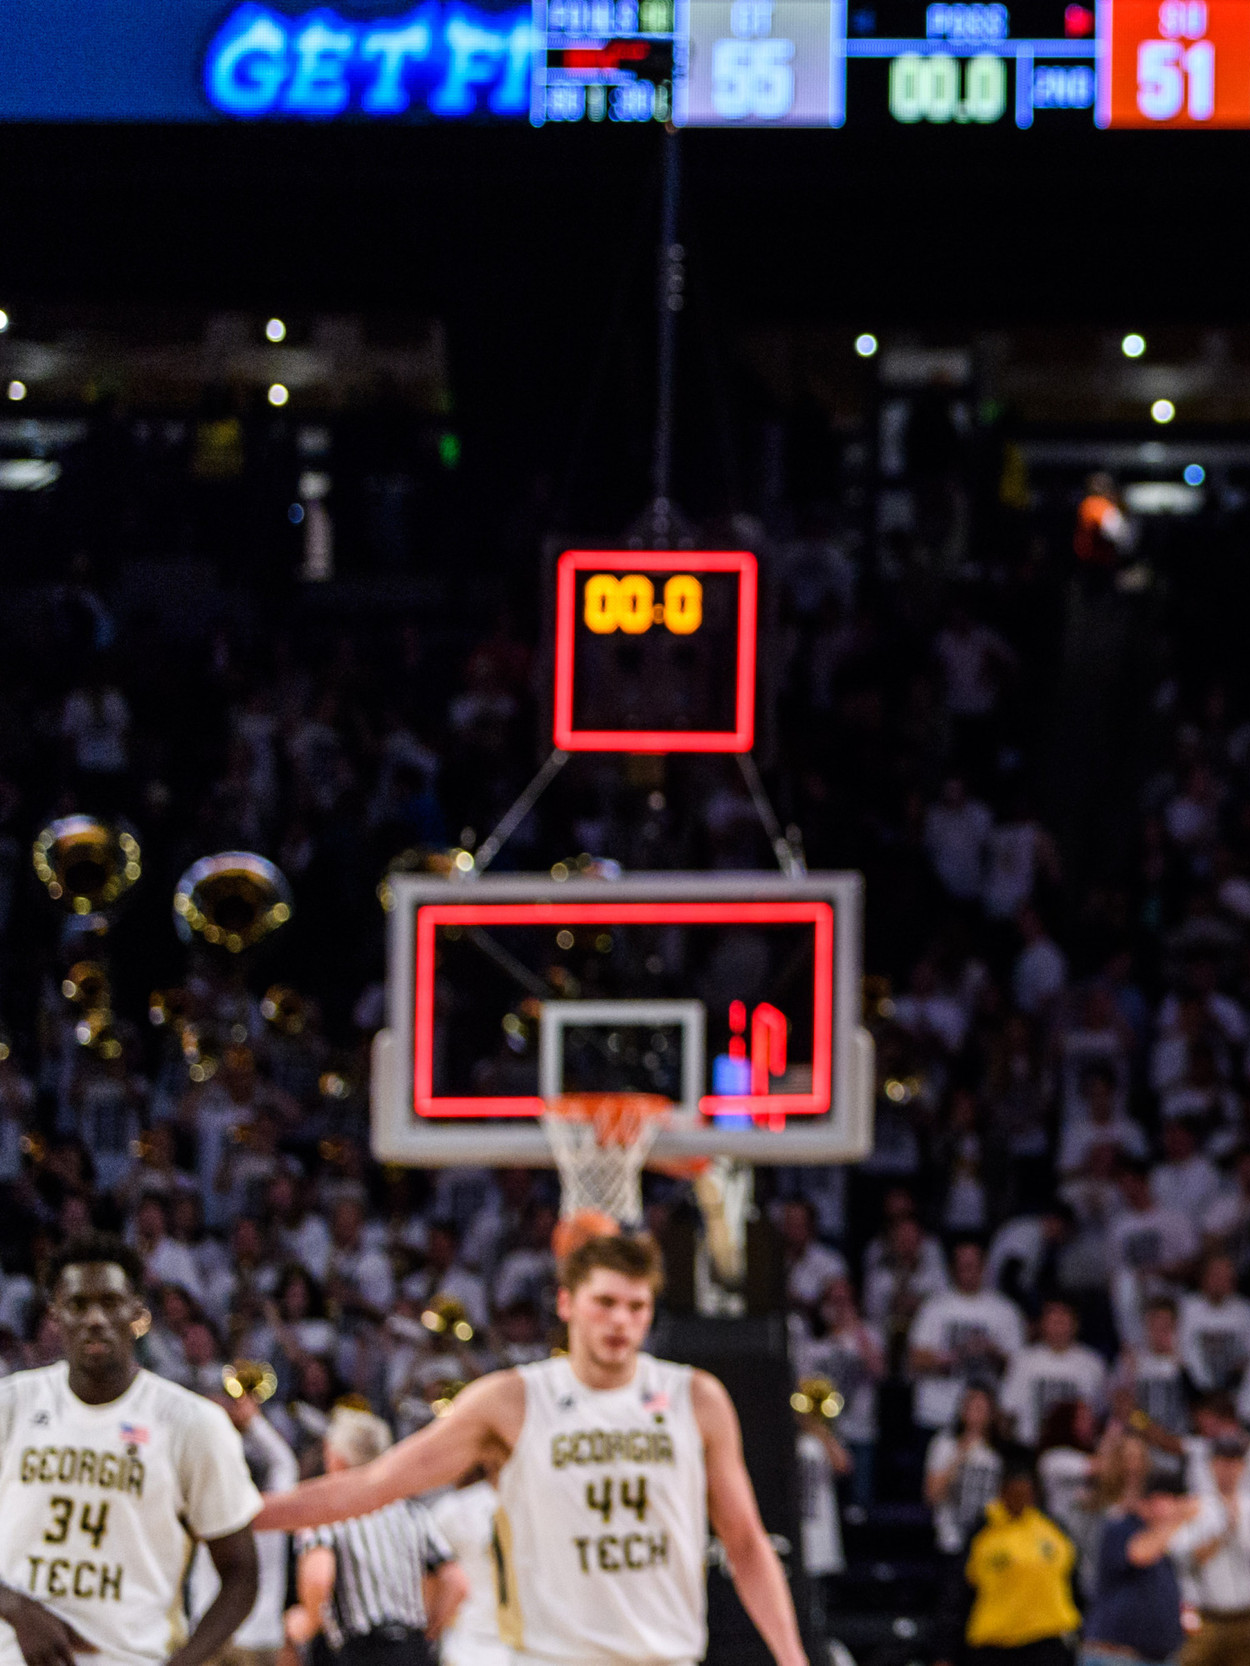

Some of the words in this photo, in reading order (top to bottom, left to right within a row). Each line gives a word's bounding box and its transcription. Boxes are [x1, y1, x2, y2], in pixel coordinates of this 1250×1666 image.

[209, 12, 430, 115] GET
[712, 38, 796, 120] 55
[888, 52, 1007, 124] 00.0
[1137, 39, 1215, 121] 51
[20, 1446, 145, 1500] GEORGIA
[553, 1429, 675, 1469] GEORGIA
[43, 1496, 110, 1548] 34
[585, 1476, 648, 1523] 44
[27, 1556, 123, 1601] TECH
[573, 1532, 670, 1574] TECH
